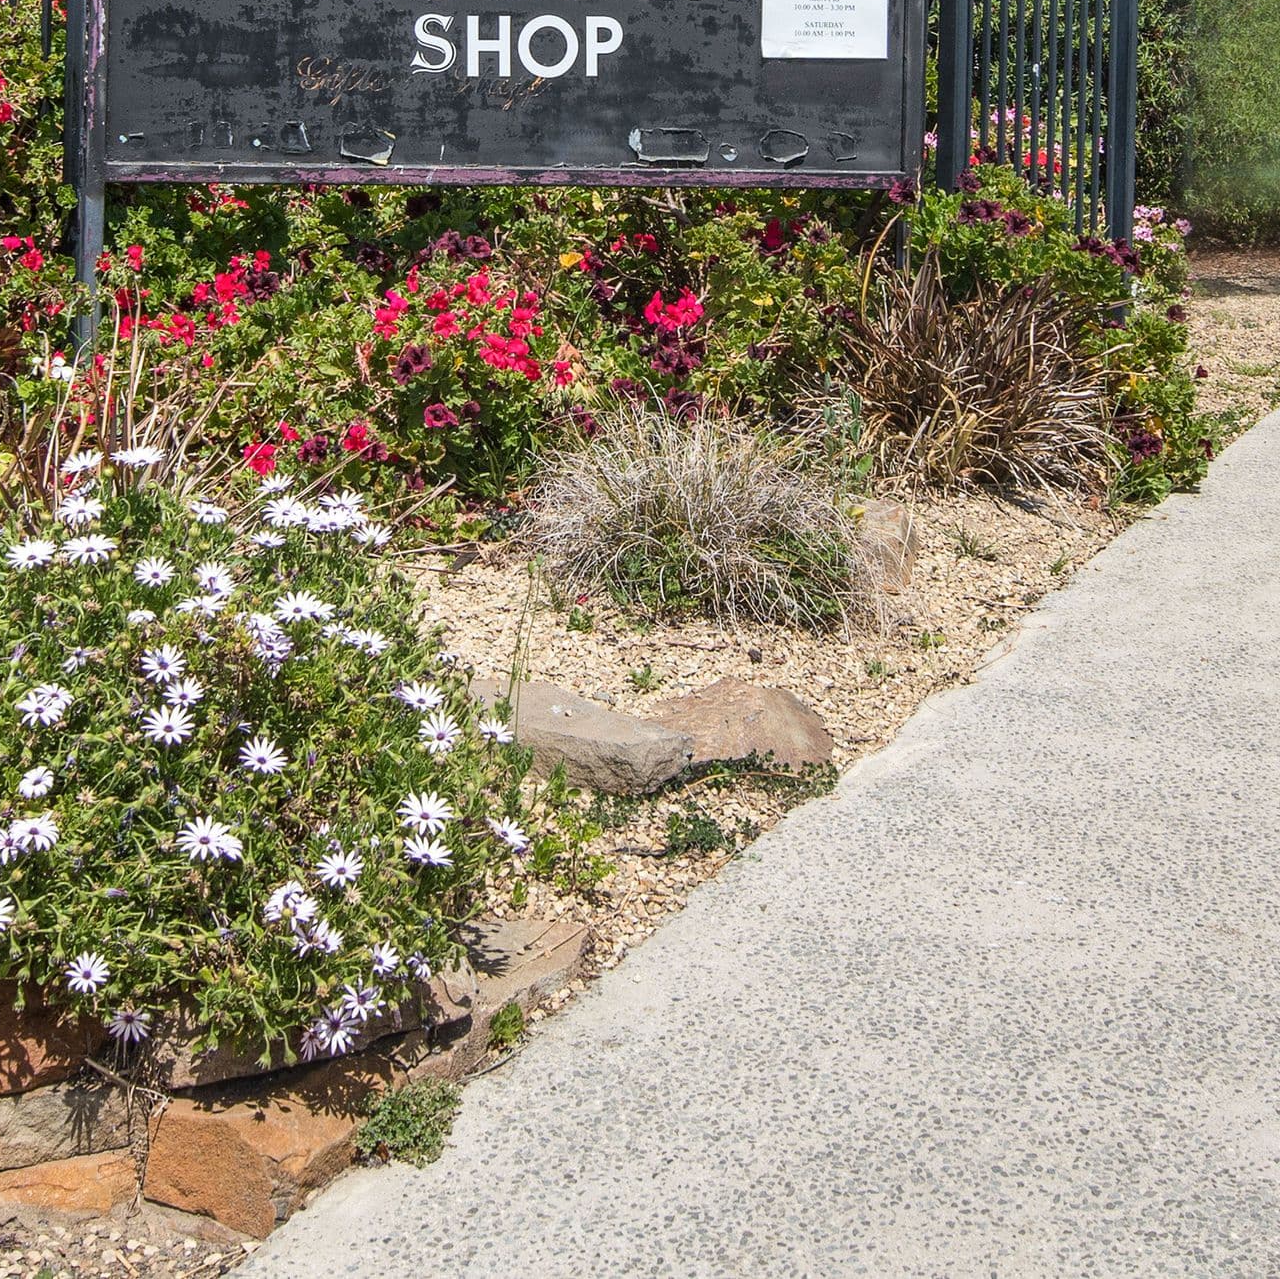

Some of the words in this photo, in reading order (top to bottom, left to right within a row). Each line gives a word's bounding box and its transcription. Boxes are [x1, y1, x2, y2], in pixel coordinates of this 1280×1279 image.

[804, 21, 844, 29] SATURDAY
[844, 30, 856, 38] PM
[410, 13, 624, 80] SHOP
